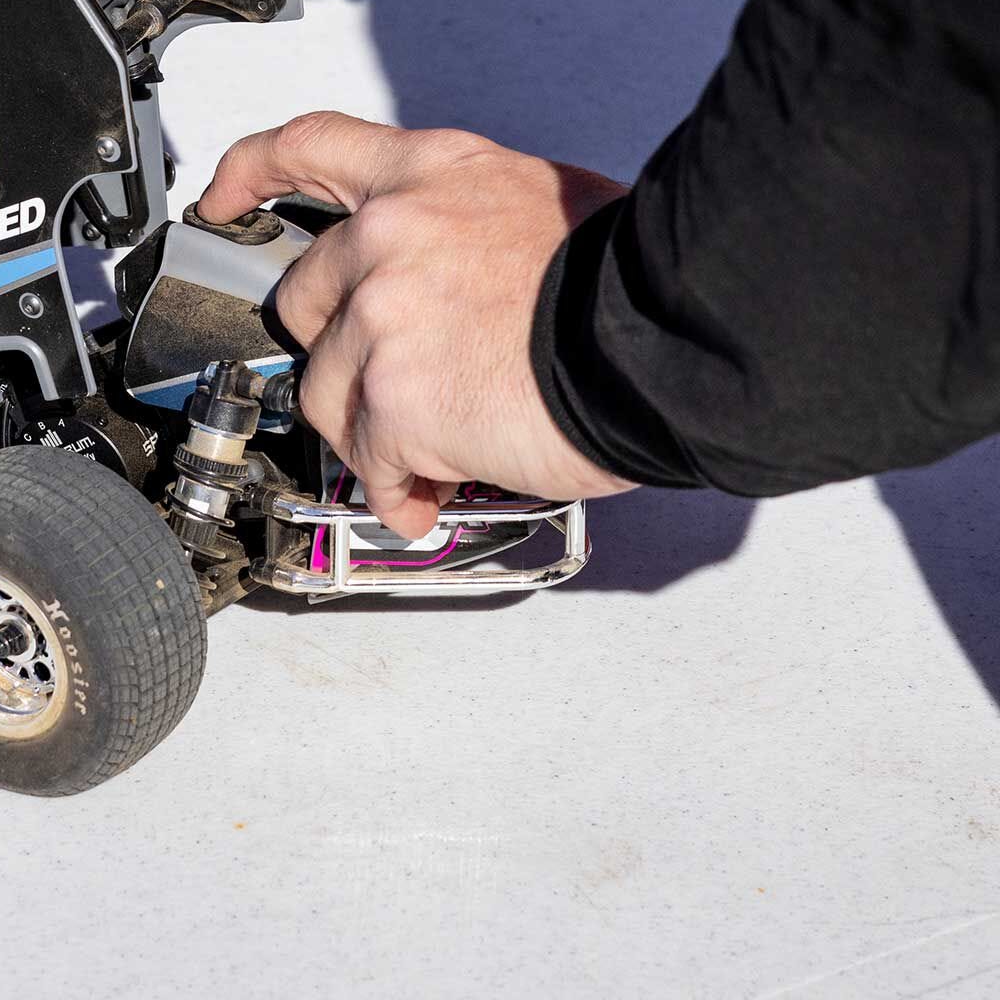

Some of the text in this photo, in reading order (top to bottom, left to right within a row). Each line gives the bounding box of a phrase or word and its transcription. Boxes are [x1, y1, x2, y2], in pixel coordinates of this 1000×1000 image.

[37, 421, 46, 430] B
[58, 418, 65, 427] A
[41, 598, 89, 716] Hoosier
